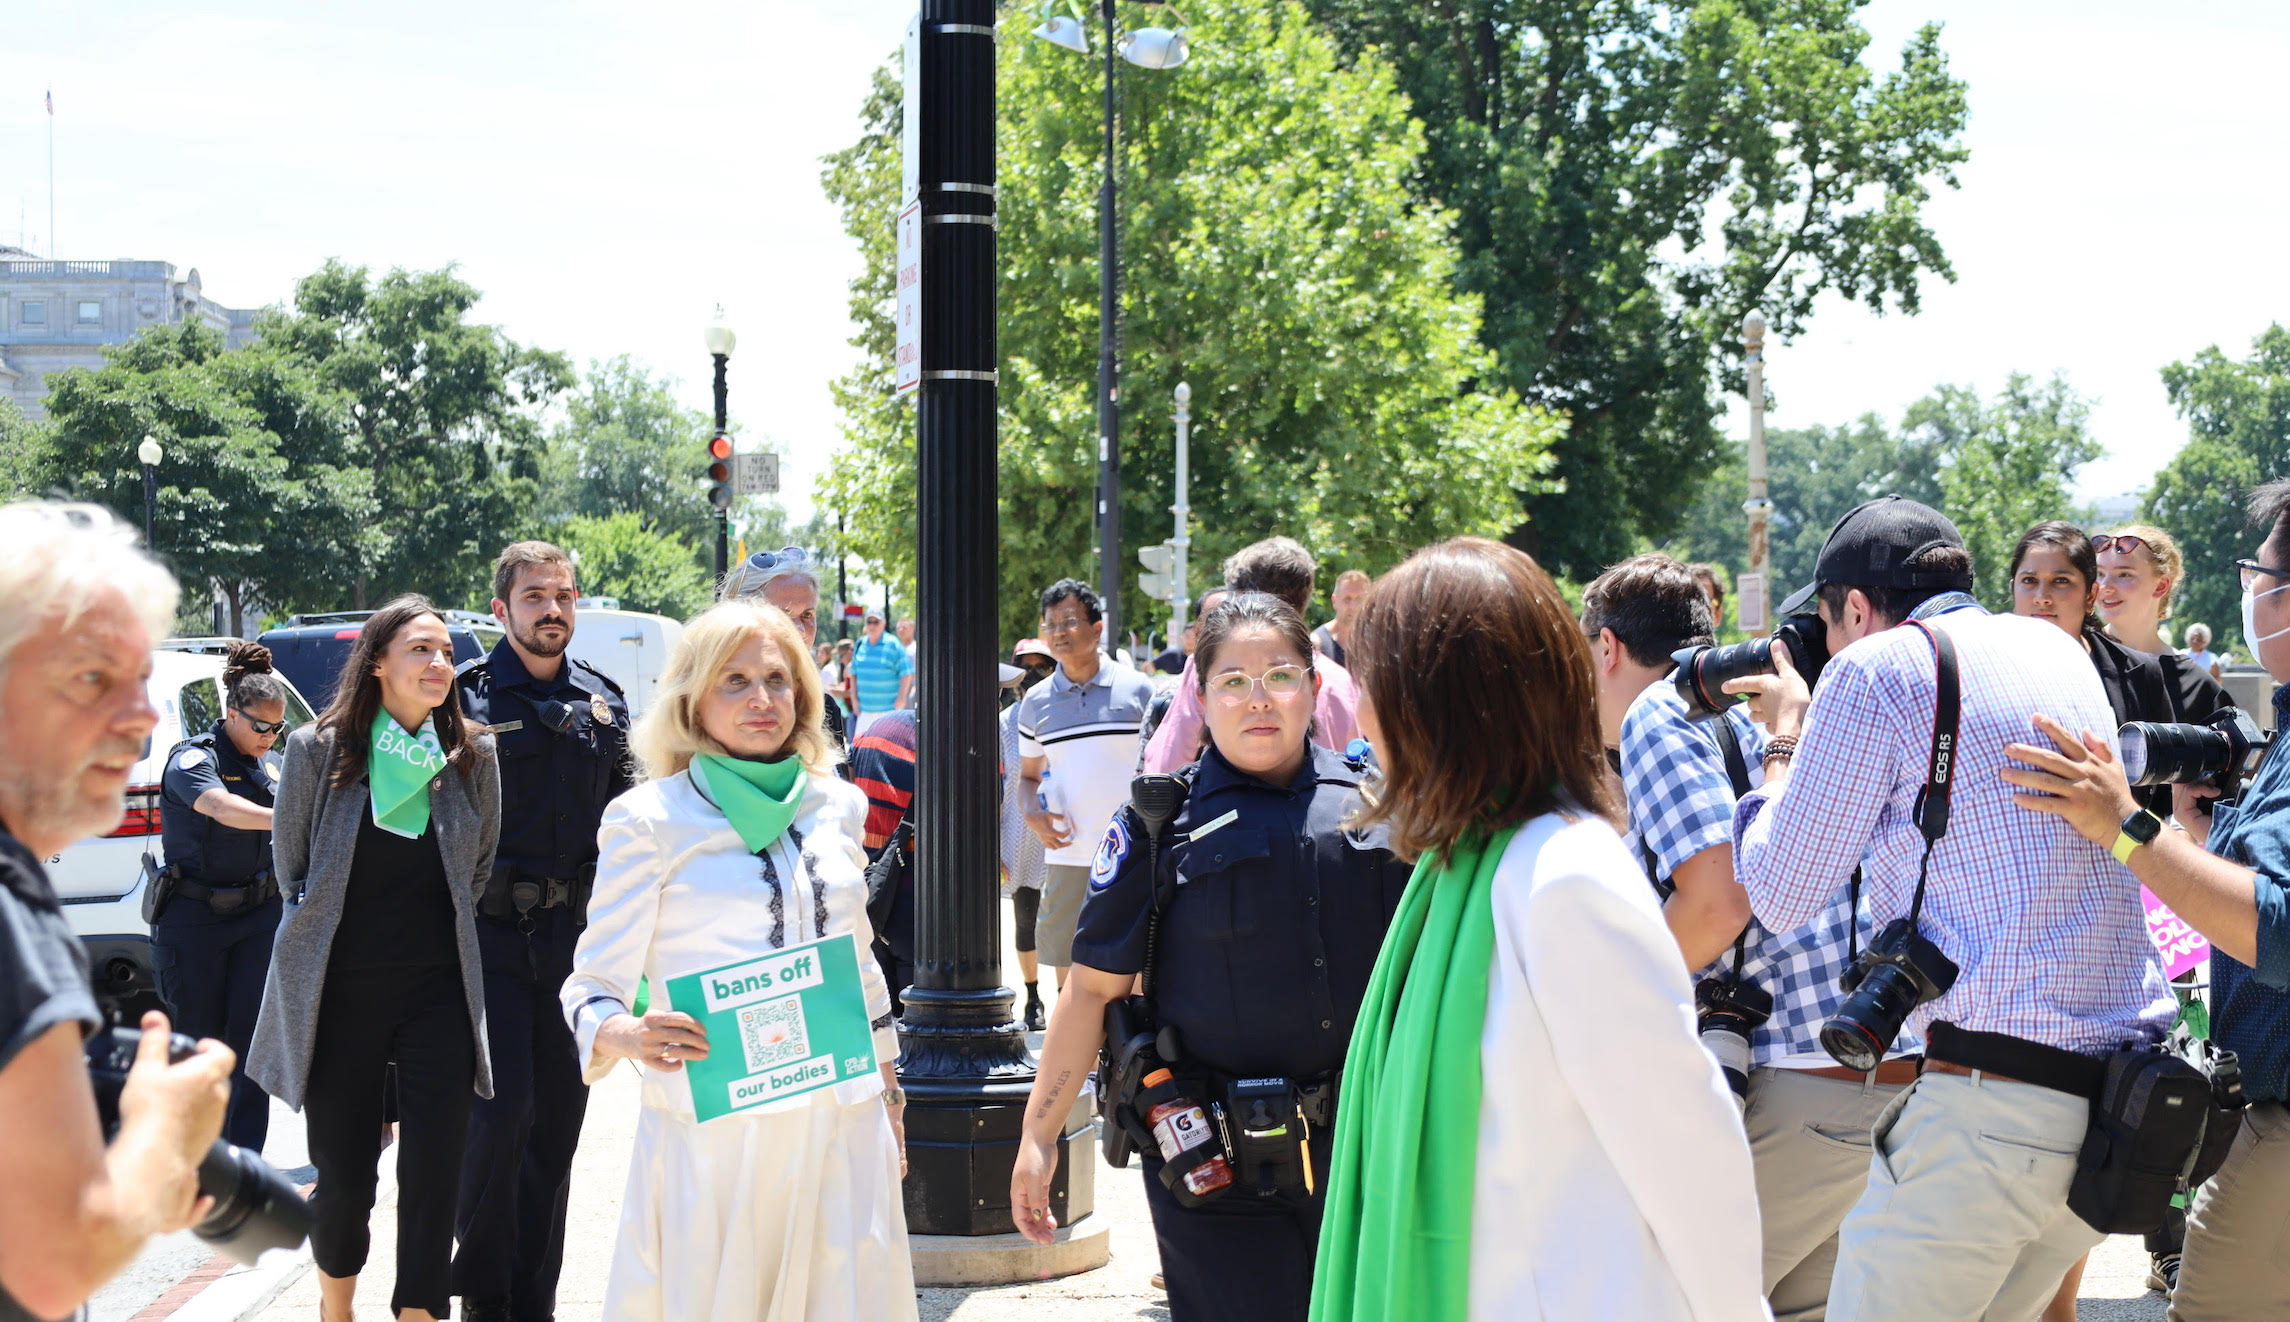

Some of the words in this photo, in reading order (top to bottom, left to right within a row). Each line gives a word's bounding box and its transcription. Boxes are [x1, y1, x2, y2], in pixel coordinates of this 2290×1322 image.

[748, 465, 770, 473] TURN
[751, 457, 765, 465] NO
[375, 730, 437, 772] BACK
[1938, 733, 1951, 750] R5
[1935, 752, 1949, 784] EOS
[711, 972, 772, 1000] bans
[779, 955, 812, 982] off
[736, 1081, 765, 1099] our
[770, 1063, 829, 1090] bodies
[1175, 1113, 1193, 1131] G
